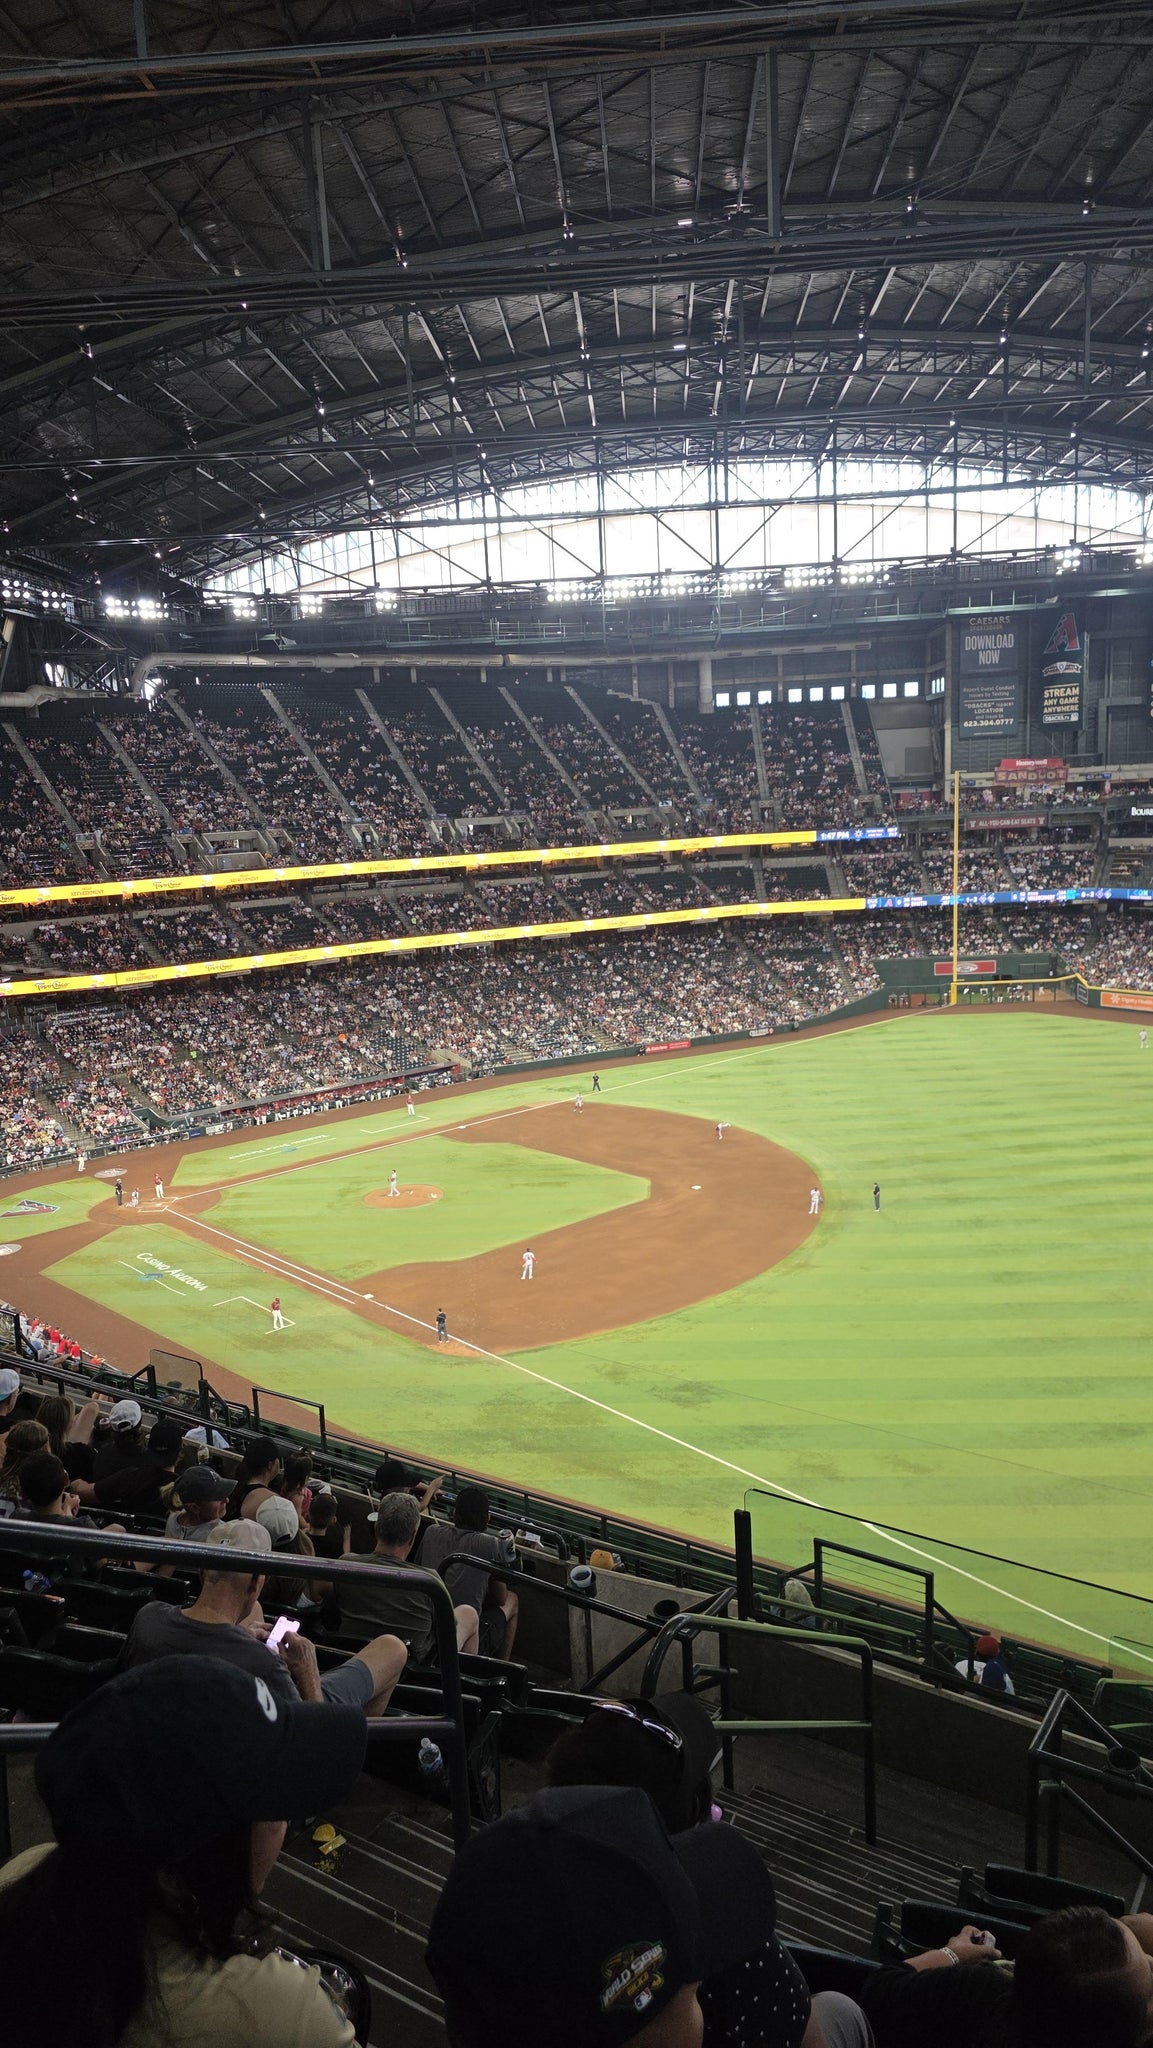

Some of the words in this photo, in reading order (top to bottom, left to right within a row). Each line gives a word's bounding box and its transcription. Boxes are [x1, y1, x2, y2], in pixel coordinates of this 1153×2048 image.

[969, 616, 1010, 626] CAESARS
[964, 634, 1014, 650] DOWNLOAD
[979, 650, 1000, 664] NOW
[1044, 686, 1080, 698] STREAM
[1059, 696, 1079, 705] GAME
[1044, 705, 1079, 714] ANYWHERE
[963, 718, 1014, 728] 623.304.0777
[1016, 758, 1048, 767] Honeywell
[997, 769, 1066, 780] SANDLOT
[820, 832, 836, 840] 1:47
[837, 831, 850, 839] PM
[35, 982, 52, 991] Topo
[136, 1252, 170, 1271] CASINO
[167, 1269, 208, 1292] ARIZONA
